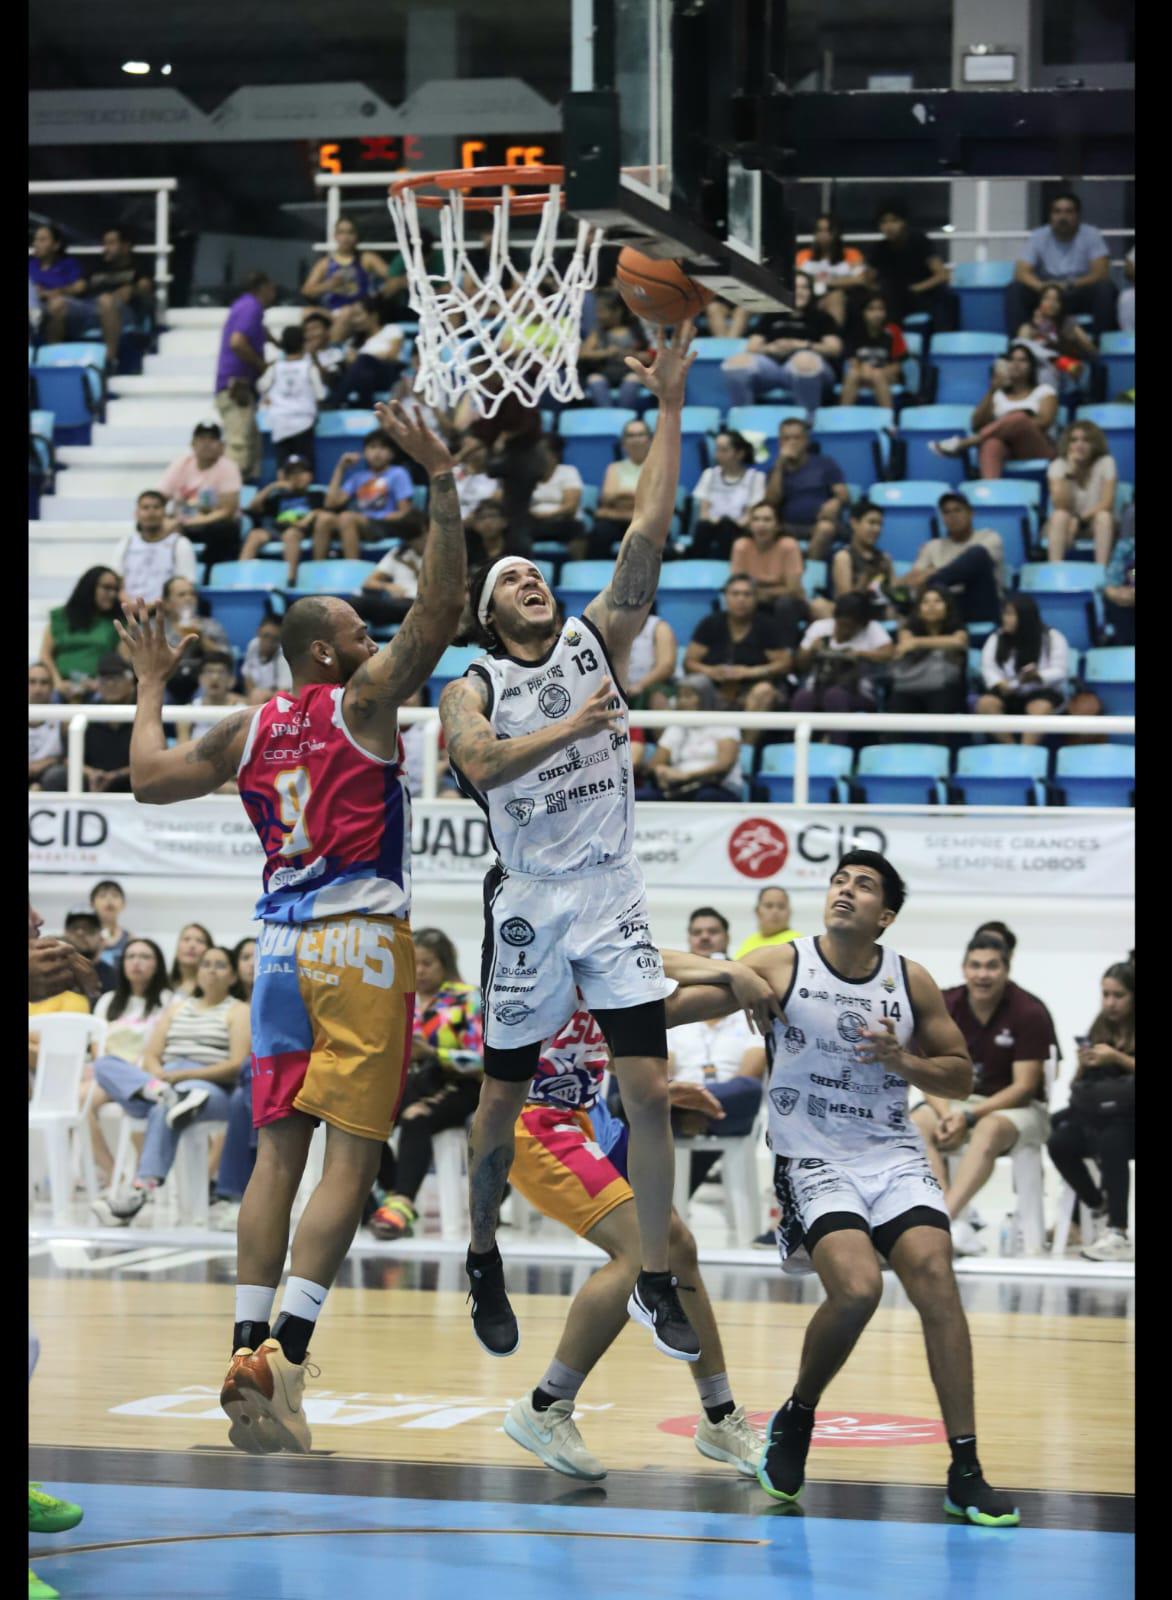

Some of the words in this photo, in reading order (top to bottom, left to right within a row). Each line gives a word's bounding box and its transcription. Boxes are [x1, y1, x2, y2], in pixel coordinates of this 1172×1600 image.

[571, 649, 599, 676] 13
[568, 778, 615, 800] HERSA
[275, 766, 313, 857] 9
[28, 809, 108, 848] CID
[798, 823, 888, 863] CID
[924, 835, 1003, 849] SIEMPRE
[1010, 836, 1101, 851] GRANDES
[936, 855, 1016, 871] SIEMPRE
[1021, 855, 1087, 872] LOBOS
[502, 966, 538, 976] DUGASA
[880, 999, 902, 1022] 14
[829, 1103, 874, 1119] HERSA
